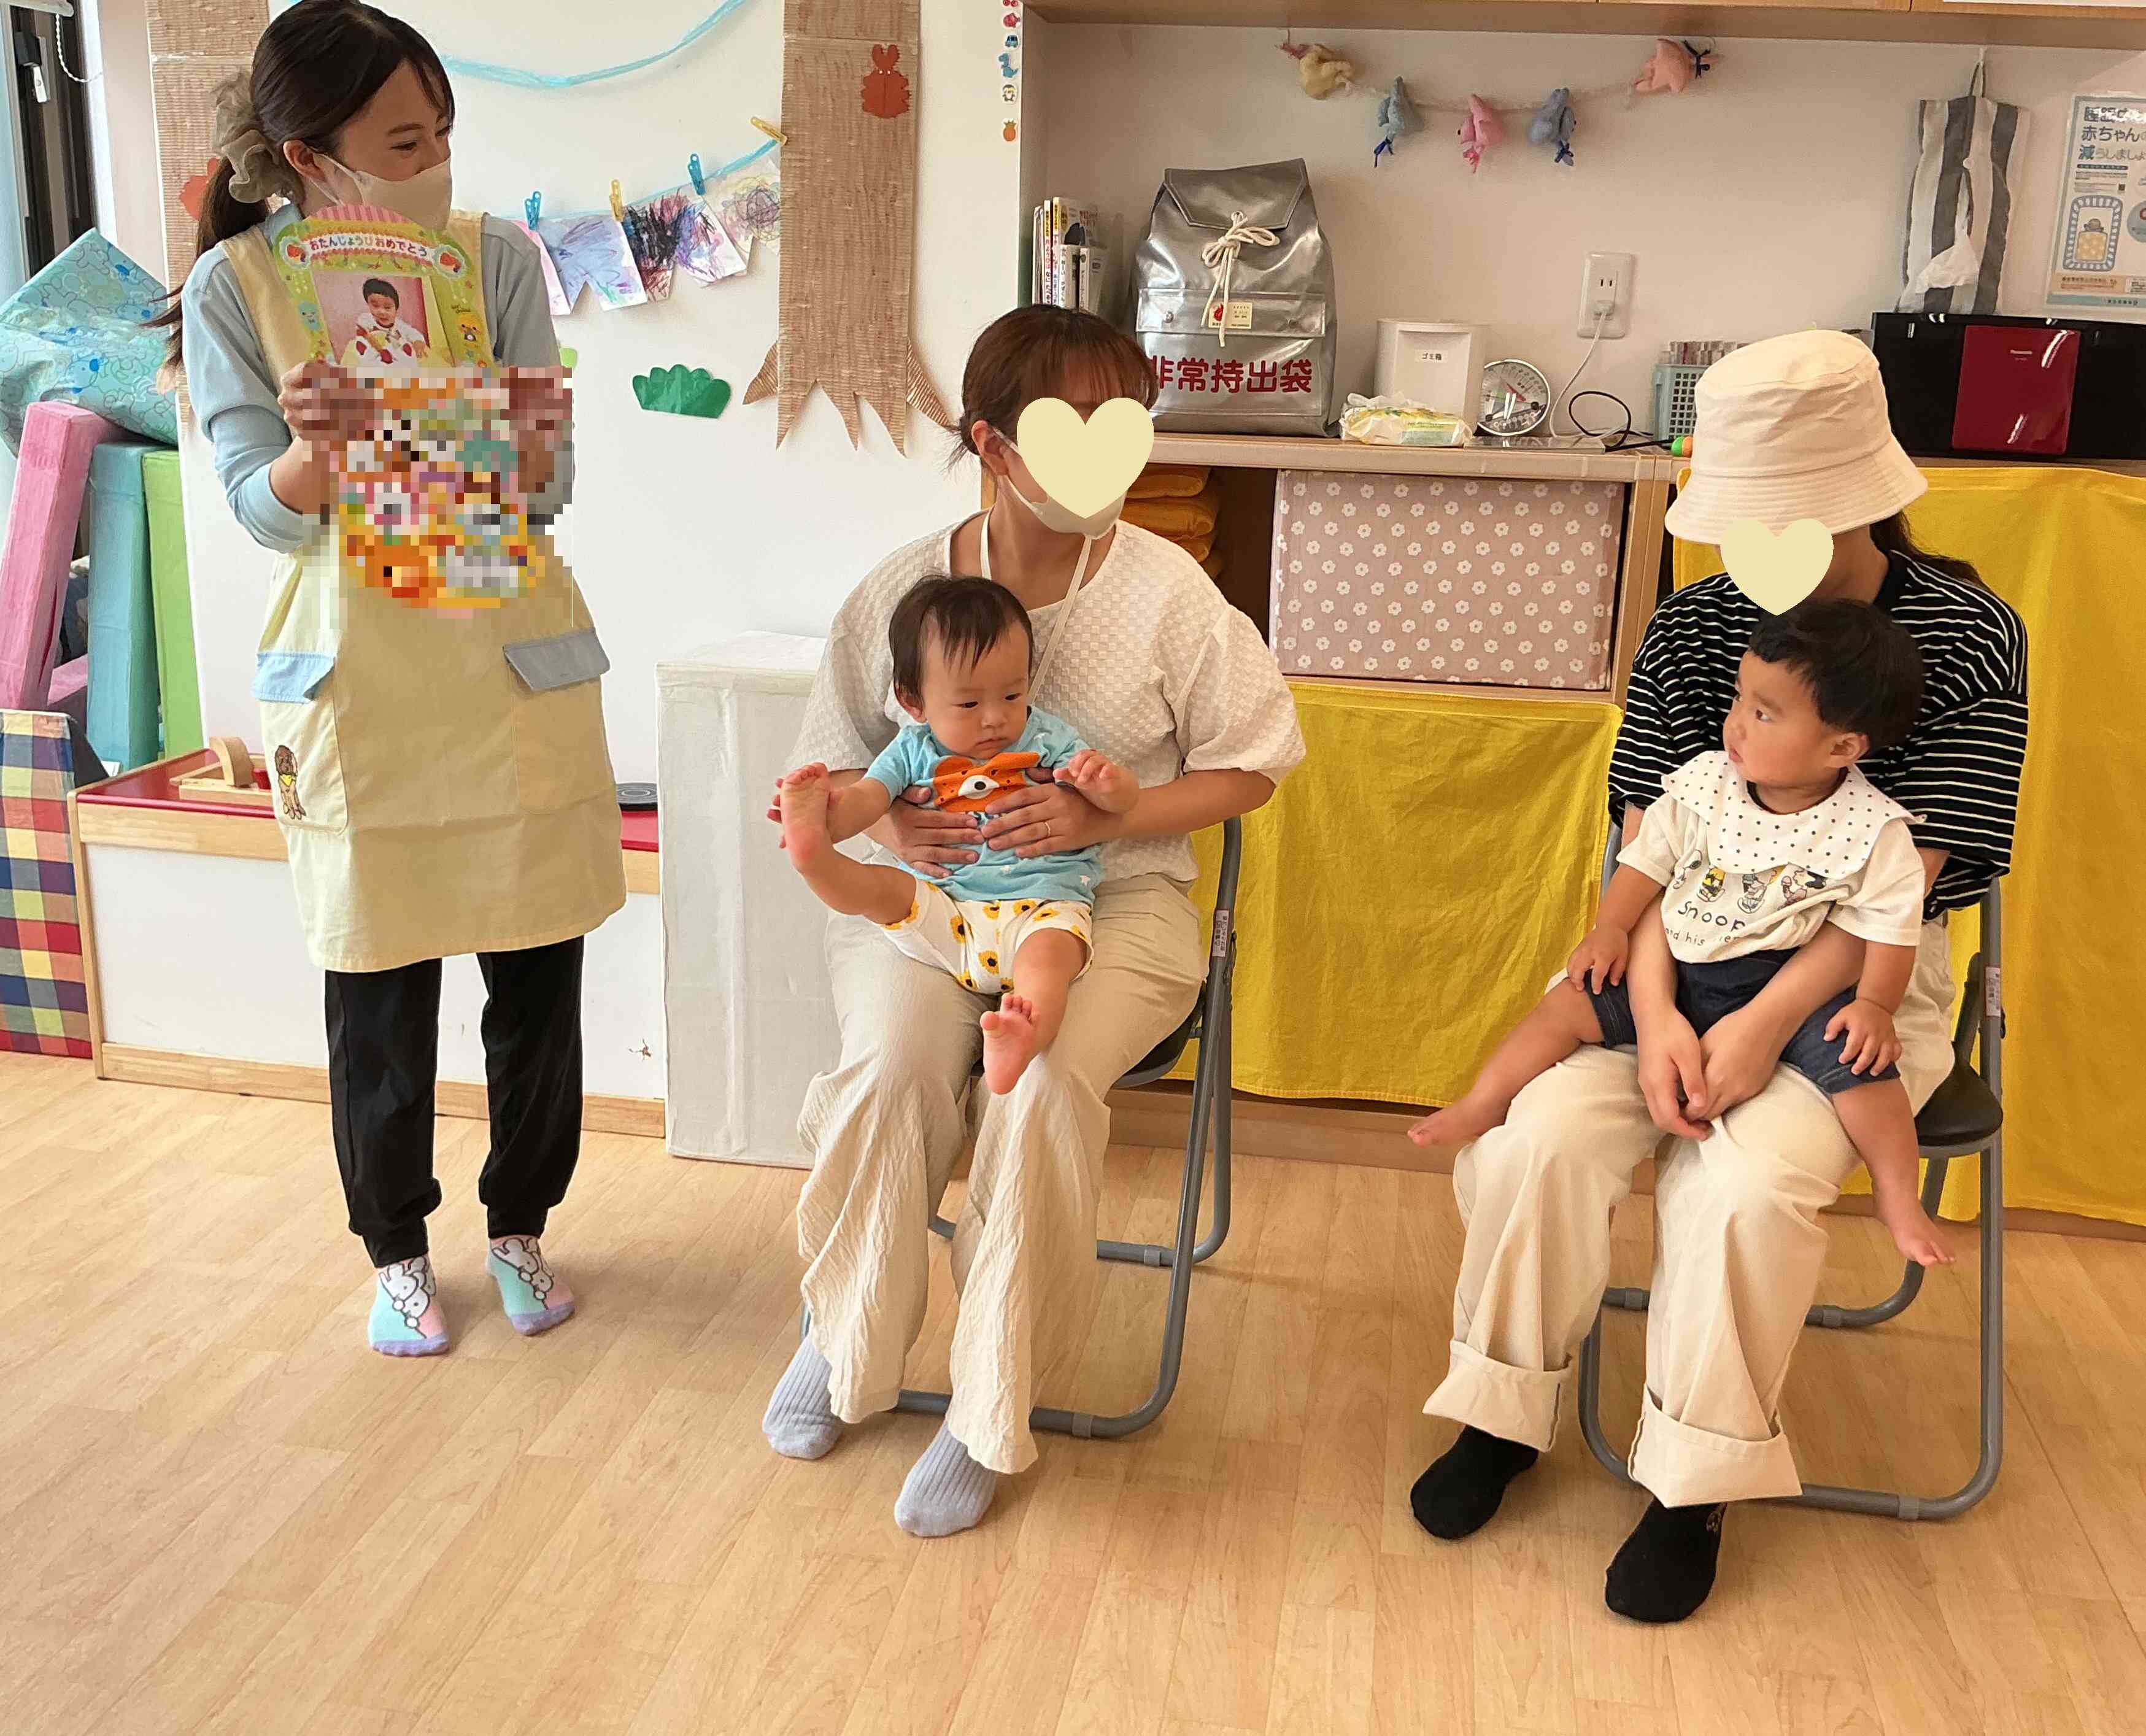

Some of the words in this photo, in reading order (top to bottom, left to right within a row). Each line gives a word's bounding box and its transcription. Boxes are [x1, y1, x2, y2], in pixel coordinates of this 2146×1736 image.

[1151, 355, 1313, 393] 非常持出袋
[1677, 900, 1747, 932] Snoop
[1685, 932, 1705, 946] his
